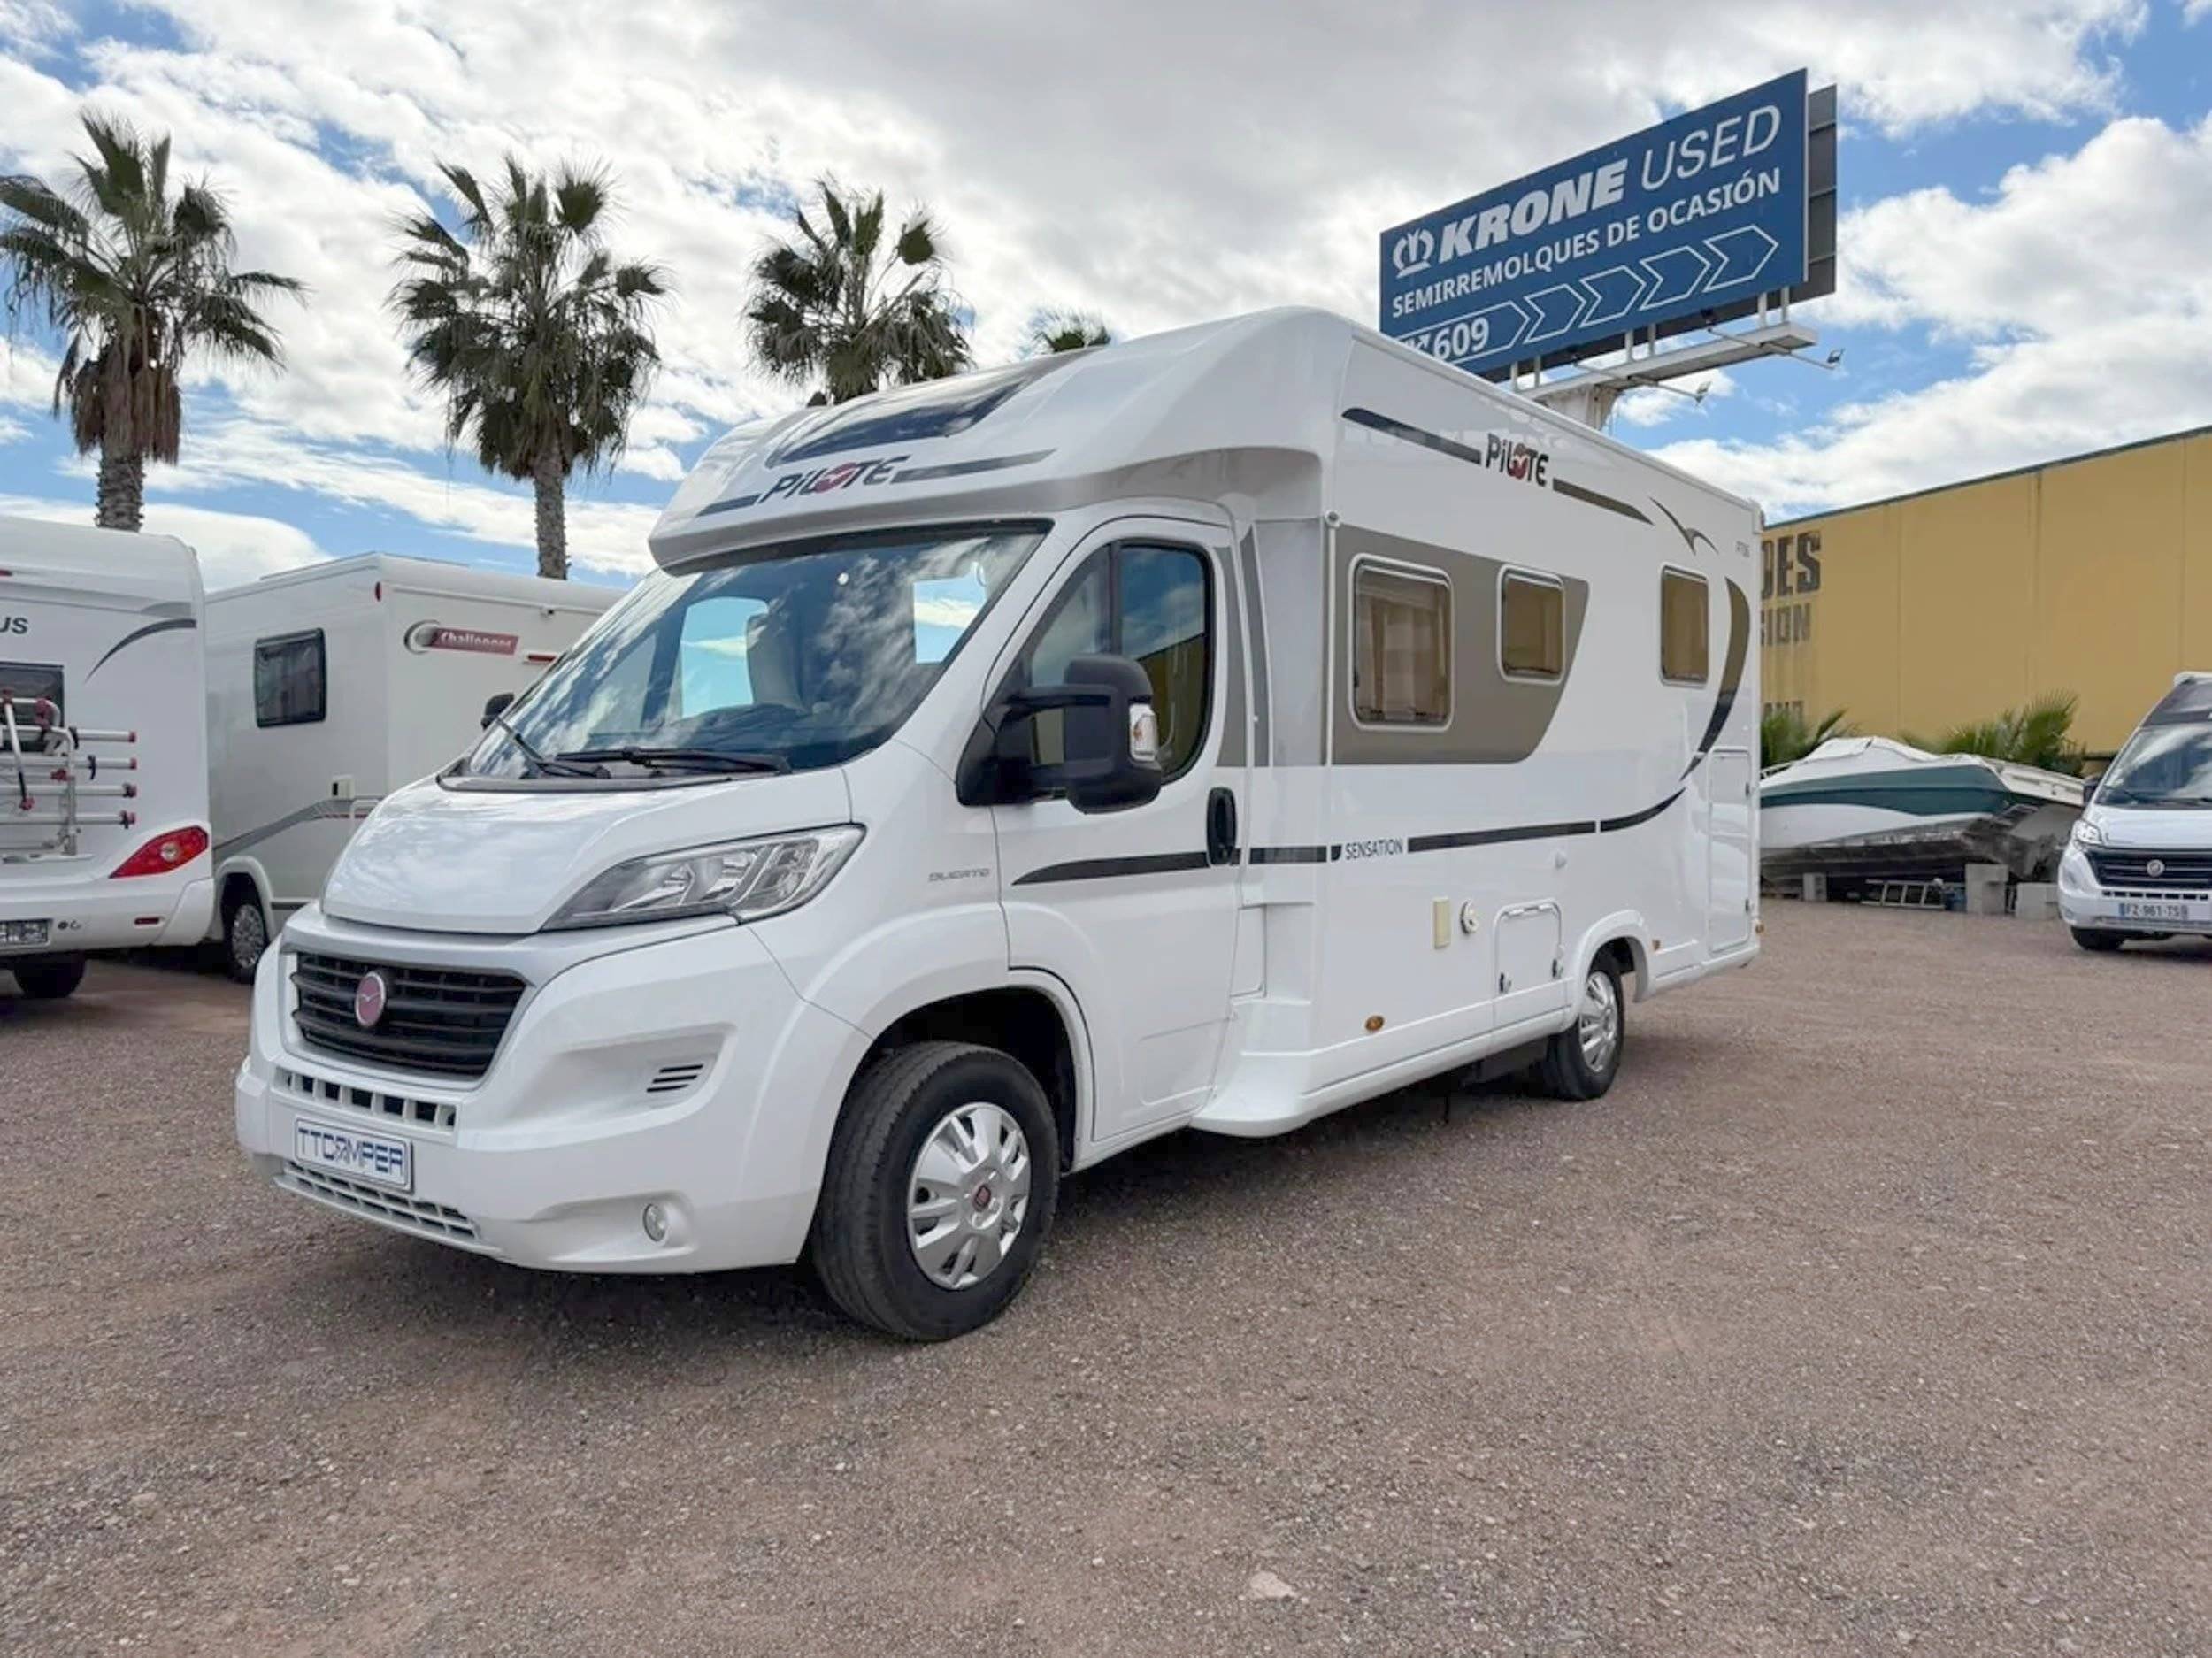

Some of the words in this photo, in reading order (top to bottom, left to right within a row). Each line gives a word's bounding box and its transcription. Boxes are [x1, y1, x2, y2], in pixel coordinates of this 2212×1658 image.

[1392, 228, 1600, 319] SEMIRREMOLQUES
[1607, 215, 1640, 249] DE
[1647, 167, 1781, 230] OCASIÓN
[1439, 159, 1628, 263] KRONE
[1641, 104, 1781, 191] USED
[1345, 837, 1402, 861] SENSATION
